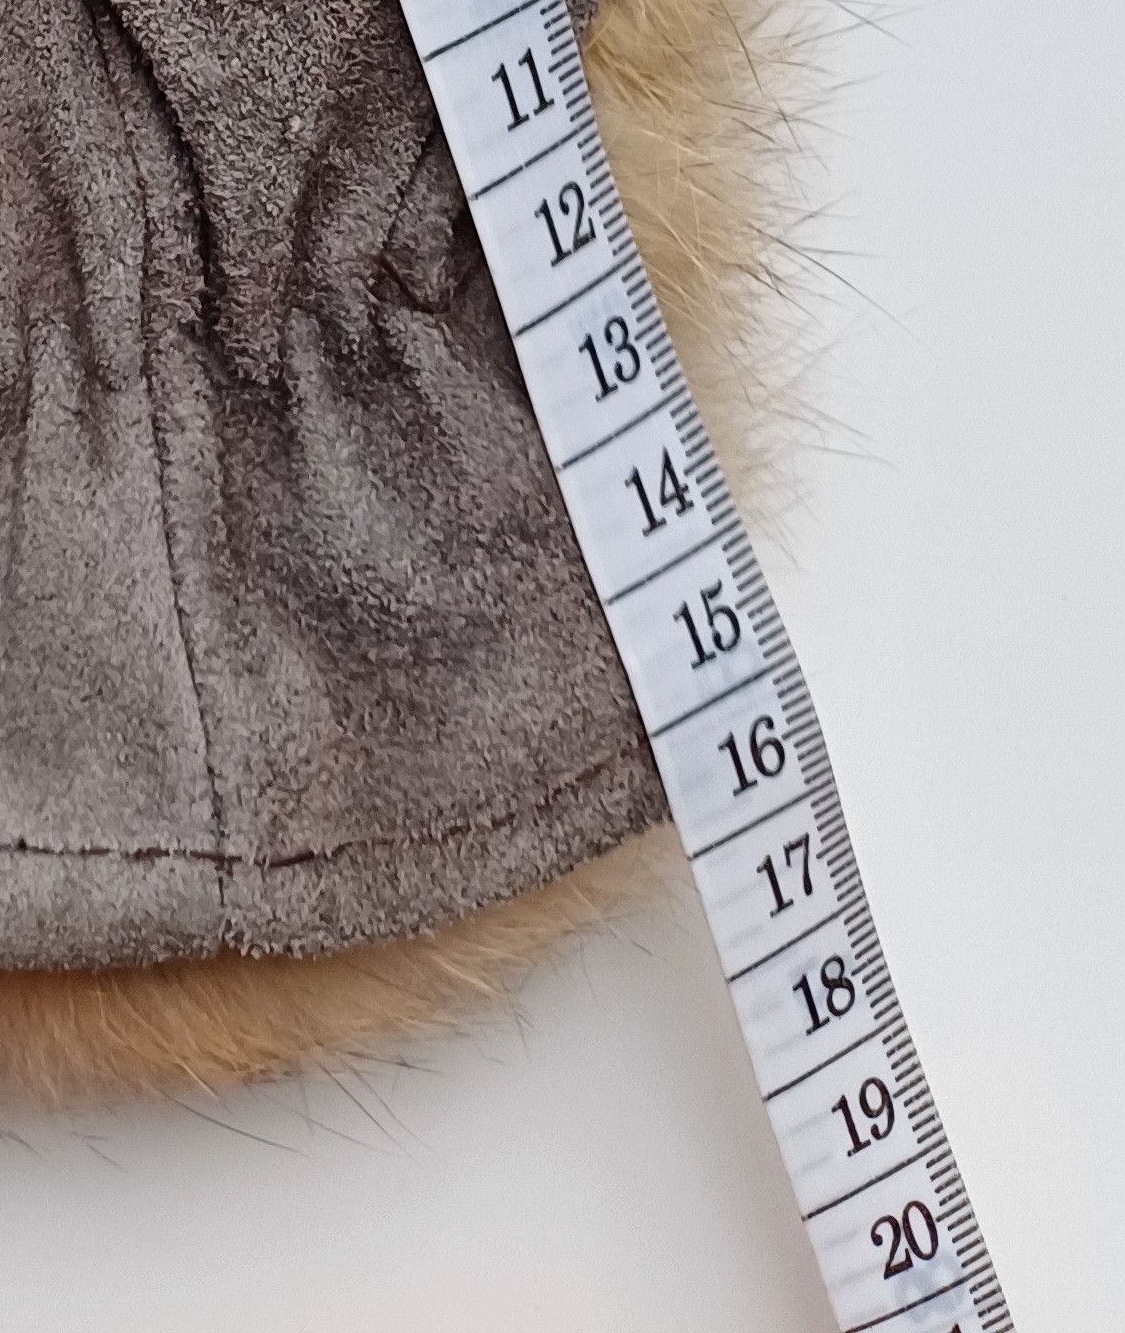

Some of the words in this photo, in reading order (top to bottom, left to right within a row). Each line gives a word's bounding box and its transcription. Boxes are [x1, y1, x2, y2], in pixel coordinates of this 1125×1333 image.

[492, 47, 554, 132] 11
[534, 181, 596, 267] 12
[578, 316, 640, 402] 13
[625, 447, 694, 537] 14
[673, 579, 741, 670] 15
[718, 715, 785, 797] 16
[757, 833, 813, 918] 17
[792, 955, 855, 1036] 18
[831, 1077, 895, 1157] 19
[871, 1201, 938, 1280] 20
